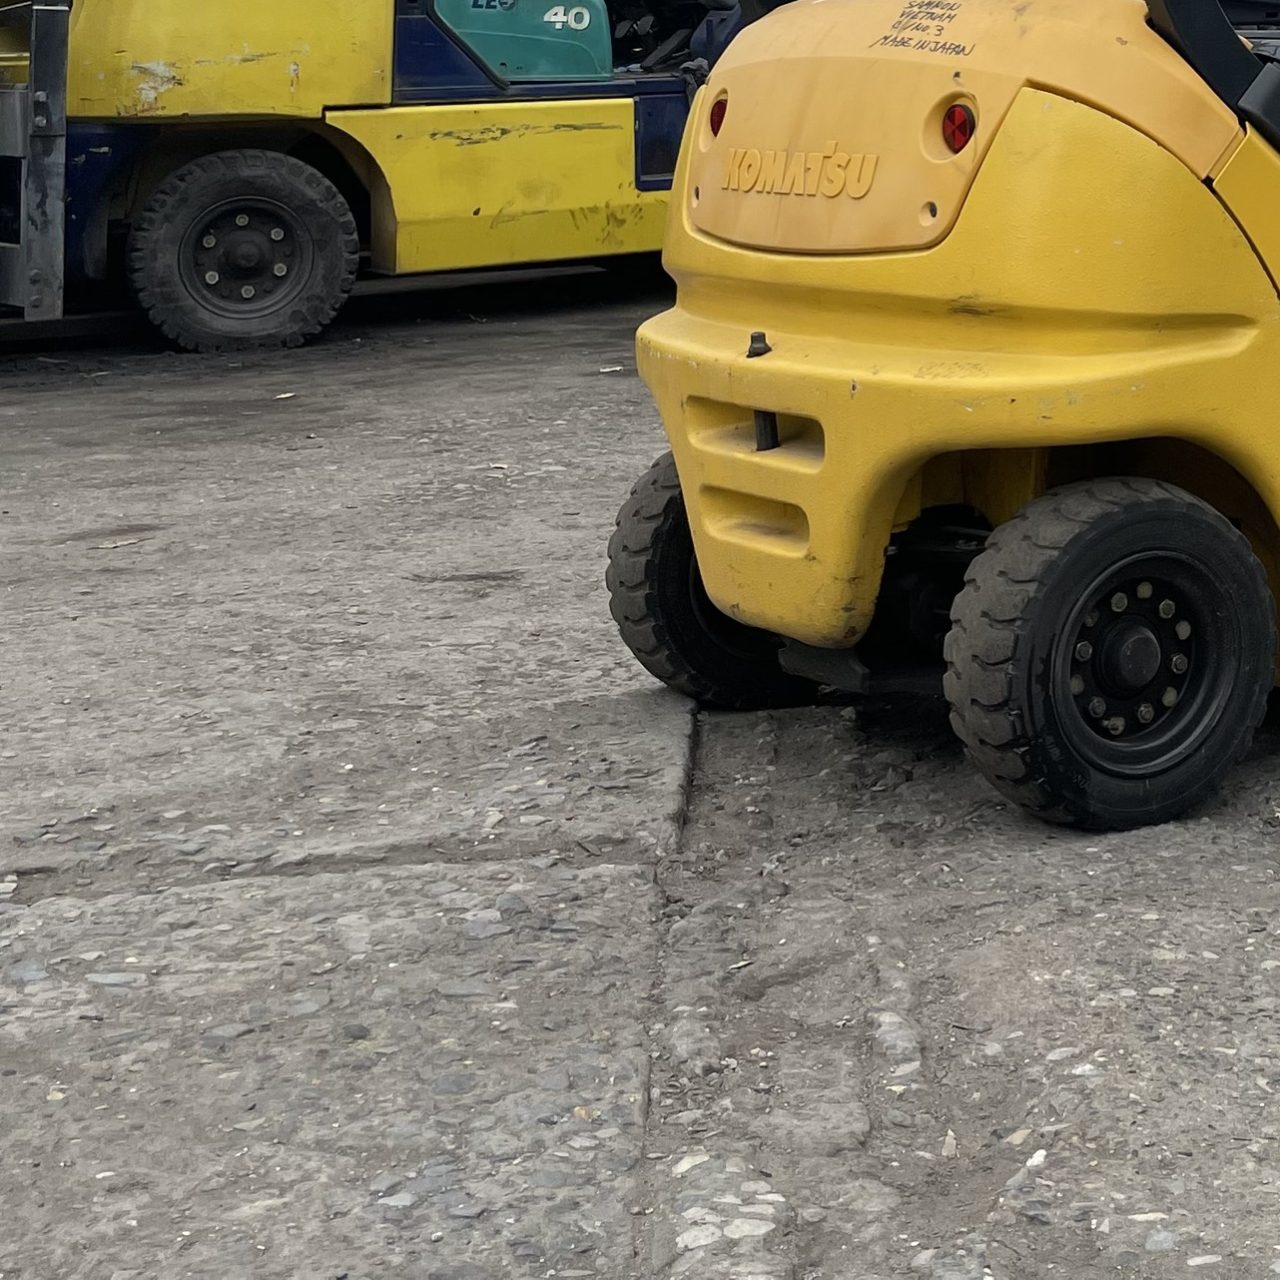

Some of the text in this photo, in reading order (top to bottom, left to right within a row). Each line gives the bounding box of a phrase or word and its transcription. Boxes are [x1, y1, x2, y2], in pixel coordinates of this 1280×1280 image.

[543, 5, 591, 30] 40
[900, 9, 957, 23] VIETNAM
[912, 40, 930, 50] IN
[929, 41, 976, 57] JAPAN
[721, 140, 880, 200] KOMATSU
